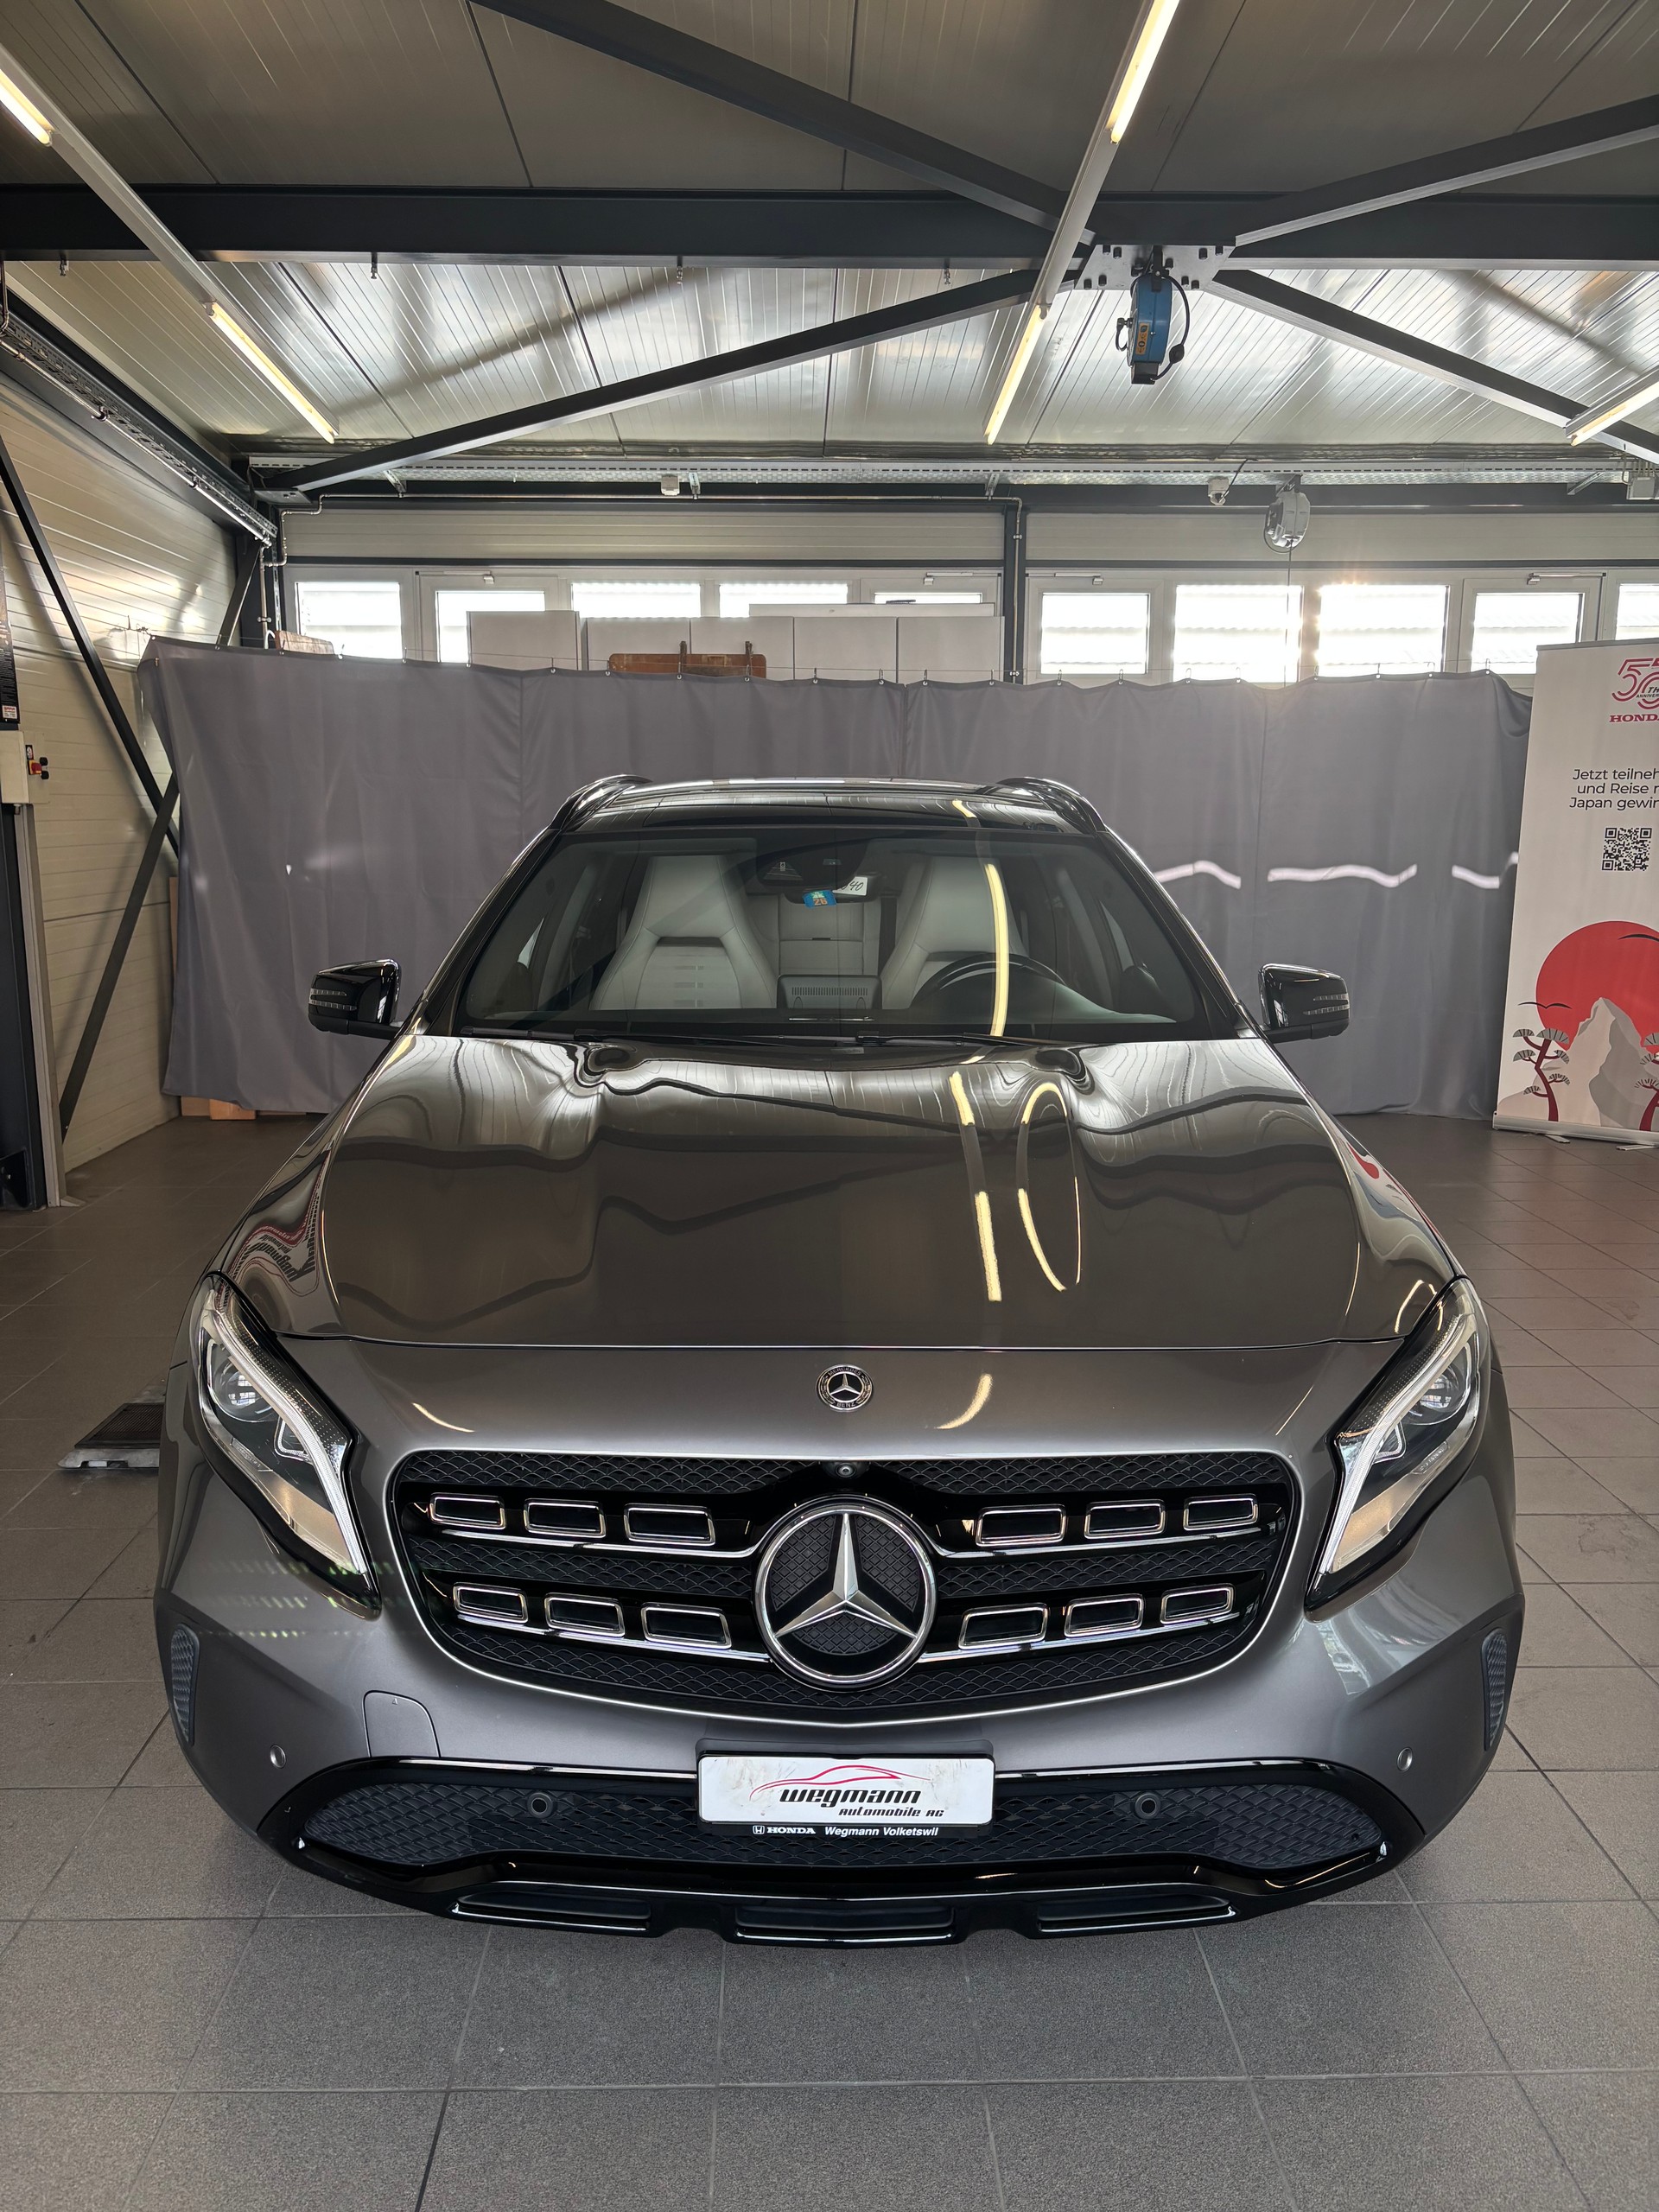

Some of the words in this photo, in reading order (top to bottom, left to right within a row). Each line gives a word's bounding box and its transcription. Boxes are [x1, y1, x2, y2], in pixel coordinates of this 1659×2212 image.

[1573, 769, 1608, 779] Jetzt
[1577, 783, 1605, 793] und
[1610, 782, 1649, 793] Reise
[1569, 798, 1612, 810] Japan
[779, 1789, 921, 1808] wegmann
[825, 1827, 880, 1837] Wegmann
[883, 1827, 939, 1836] Volketswil
